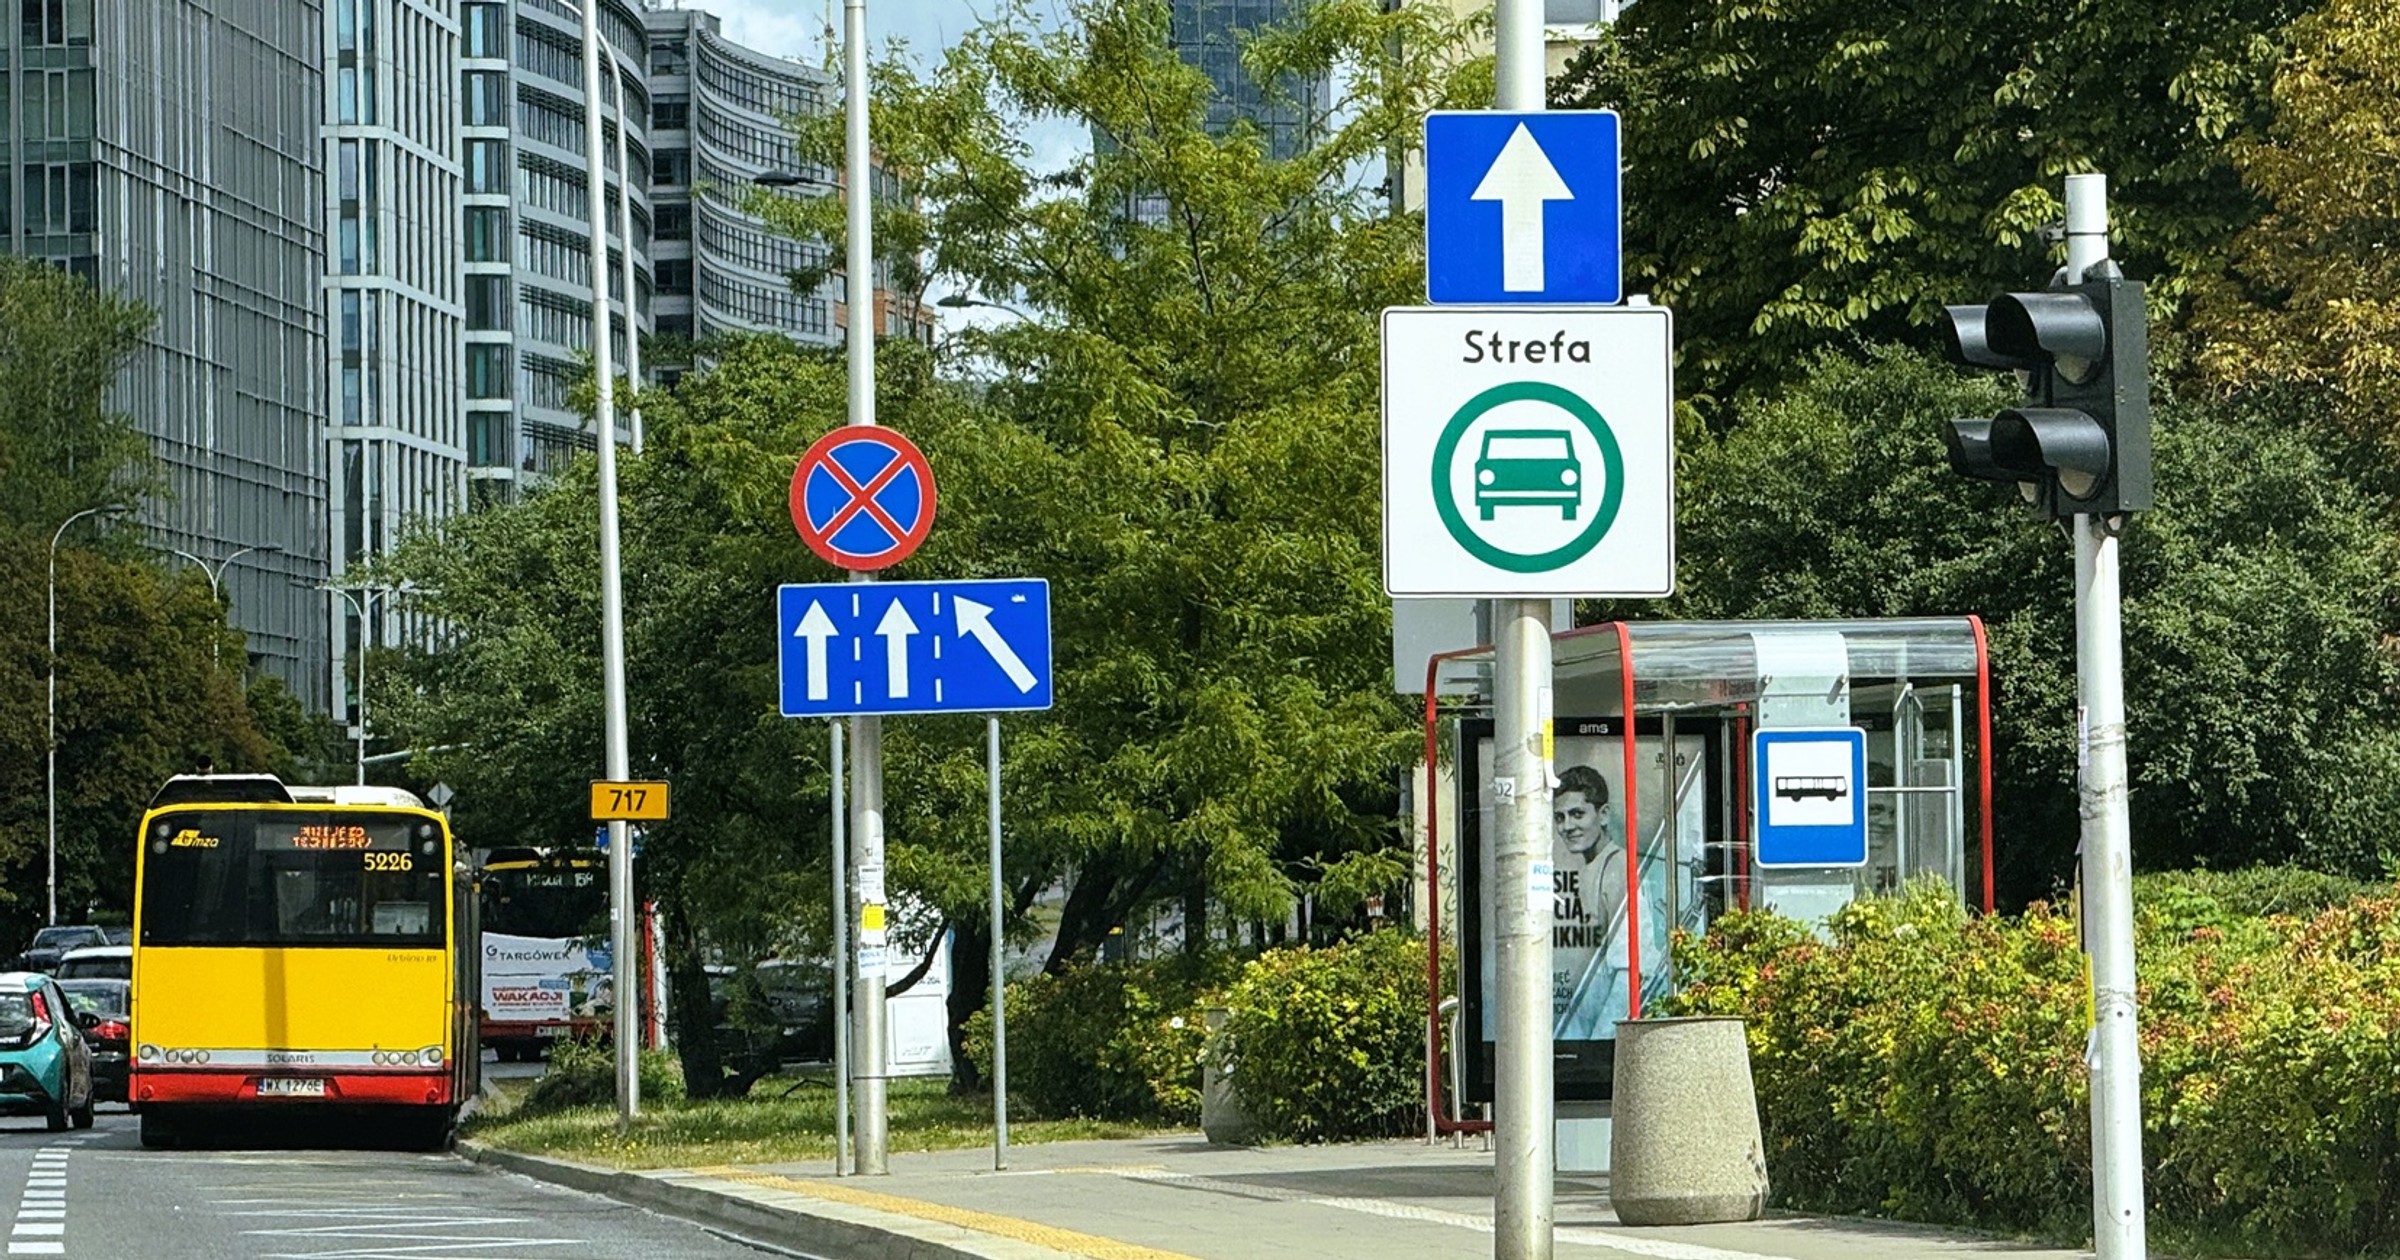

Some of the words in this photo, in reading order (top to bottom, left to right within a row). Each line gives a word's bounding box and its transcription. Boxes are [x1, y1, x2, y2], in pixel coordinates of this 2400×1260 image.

[1463, 329, 1591, 365] Strefa
[1578, 723, 1609, 734] ams
[609, 789, 647, 812] 717
[192, 837, 219, 848] mza
[363, 852, 413, 871] 5226
[500, 949, 570, 961] TARGÓWEK
[493, 991, 563, 1002] WAKACJI
[267, 1053, 315, 1063] SOLARIS
